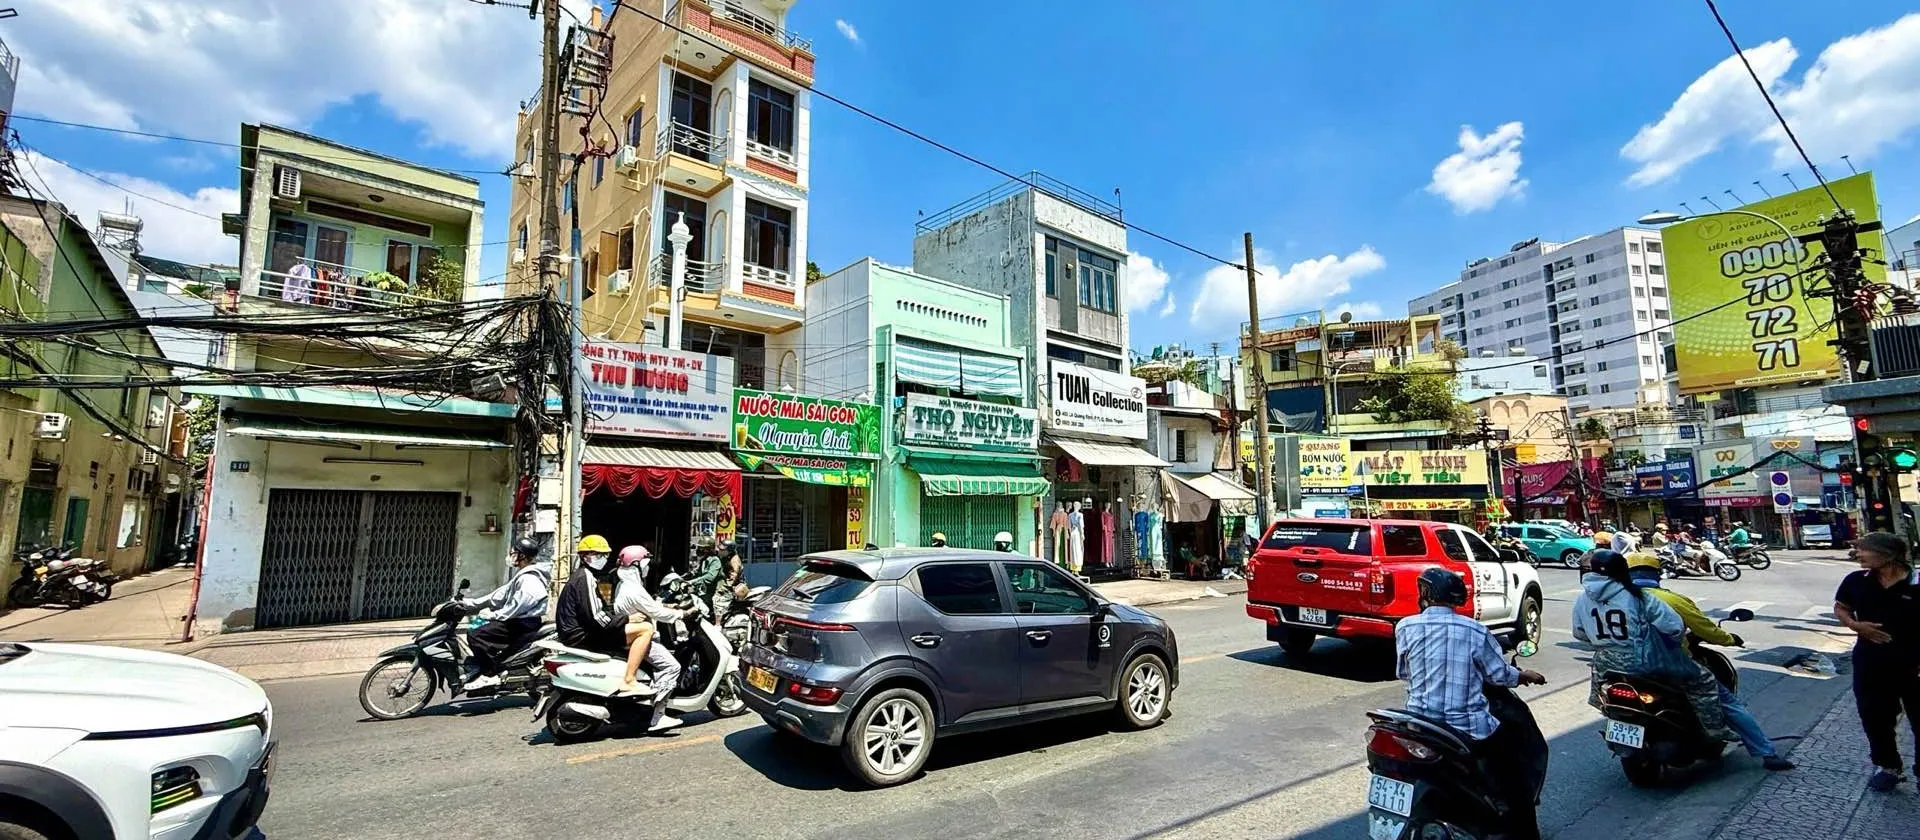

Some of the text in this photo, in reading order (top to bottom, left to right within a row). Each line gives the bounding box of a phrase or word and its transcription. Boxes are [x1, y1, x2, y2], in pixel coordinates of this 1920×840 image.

[1729, 210, 1798, 231] ADVERSING
[1742, 273, 1792, 306] 70
[1746, 306, 1798, 338] 72
[608, 348, 618, 359] TY
[623, 350, 647, 364] TNHH
[650, 354, 669, 367] MTV
[1752, 338, 1800, 371] 71
[591, 363, 690, 393] THU HƯƠNG
[1057, 371, 1143, 414] TUAN Collection
[738, 392, 856, 425] NƯỚC MÍA SÀI GÒN
[913, 406, 1034, 437] THỌ NGUYÊN
[758, 422, 852, 451] Nguyên Chất
[1306, 442, 1340, 452] QUANG
[1323, 452, 1346, 463] NƯỚC
[1365, 449, 1466, 470] MẮT KÍNH
[1374, 469, 1461, 485] VIỆT TIẾN
[1590, 608, 1629, 642] 18
[1613, 722, 1639, 737] 59-P2
[1376, 777, 1406, 798] 54-X4
[1373, 791, 1405, 812] 3110
